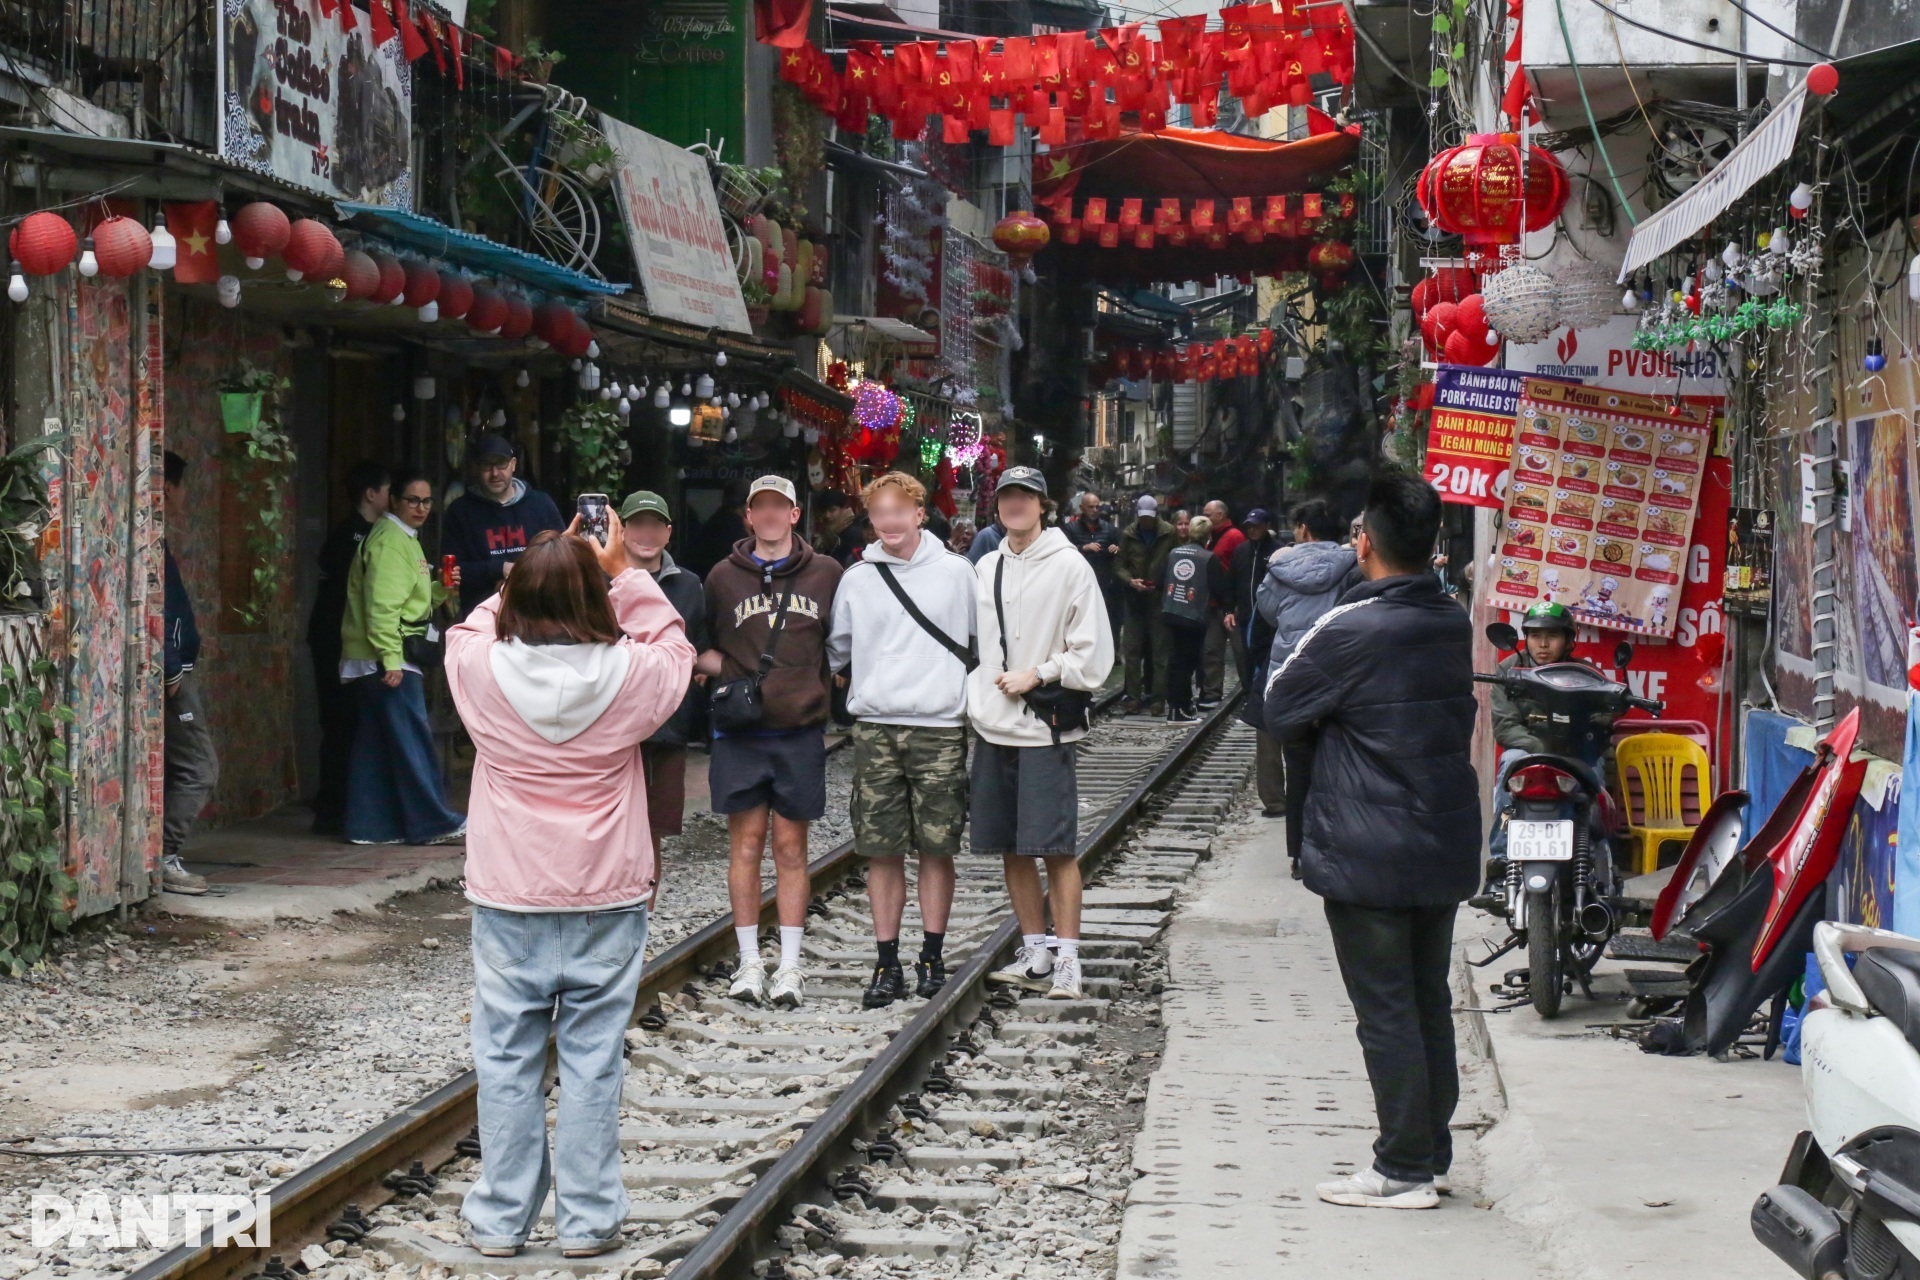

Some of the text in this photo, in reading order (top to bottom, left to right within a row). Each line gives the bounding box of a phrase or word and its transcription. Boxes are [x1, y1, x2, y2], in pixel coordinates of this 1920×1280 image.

[661, 40, 724, 62] Coffee
[1536, 364, 1599, 377] PETROVIETNAM
[1460, 372, 1486, 386] BÁNH
[1488, 377, 1507, 391] BAO
[1440, 389, 1501, 411] PORK-FILLED
[1533, 385, 1552, 397] food
[1563, 386, 1600, 406] Menu
[1437, 414, 1464, 432] BÁNH
[1465, 419, 1486, 434] BAO
[1487, 421, 1508, 439] ĐẬU
[1440, 435, 1473, 452] VEGAN
[1475, 439, 1504, 456] MUNG
[486, 524, 528, 550] HH
[1518, 823, 1562, 839] 29-D1
[1513, 841, 1567, 857] 061.61
